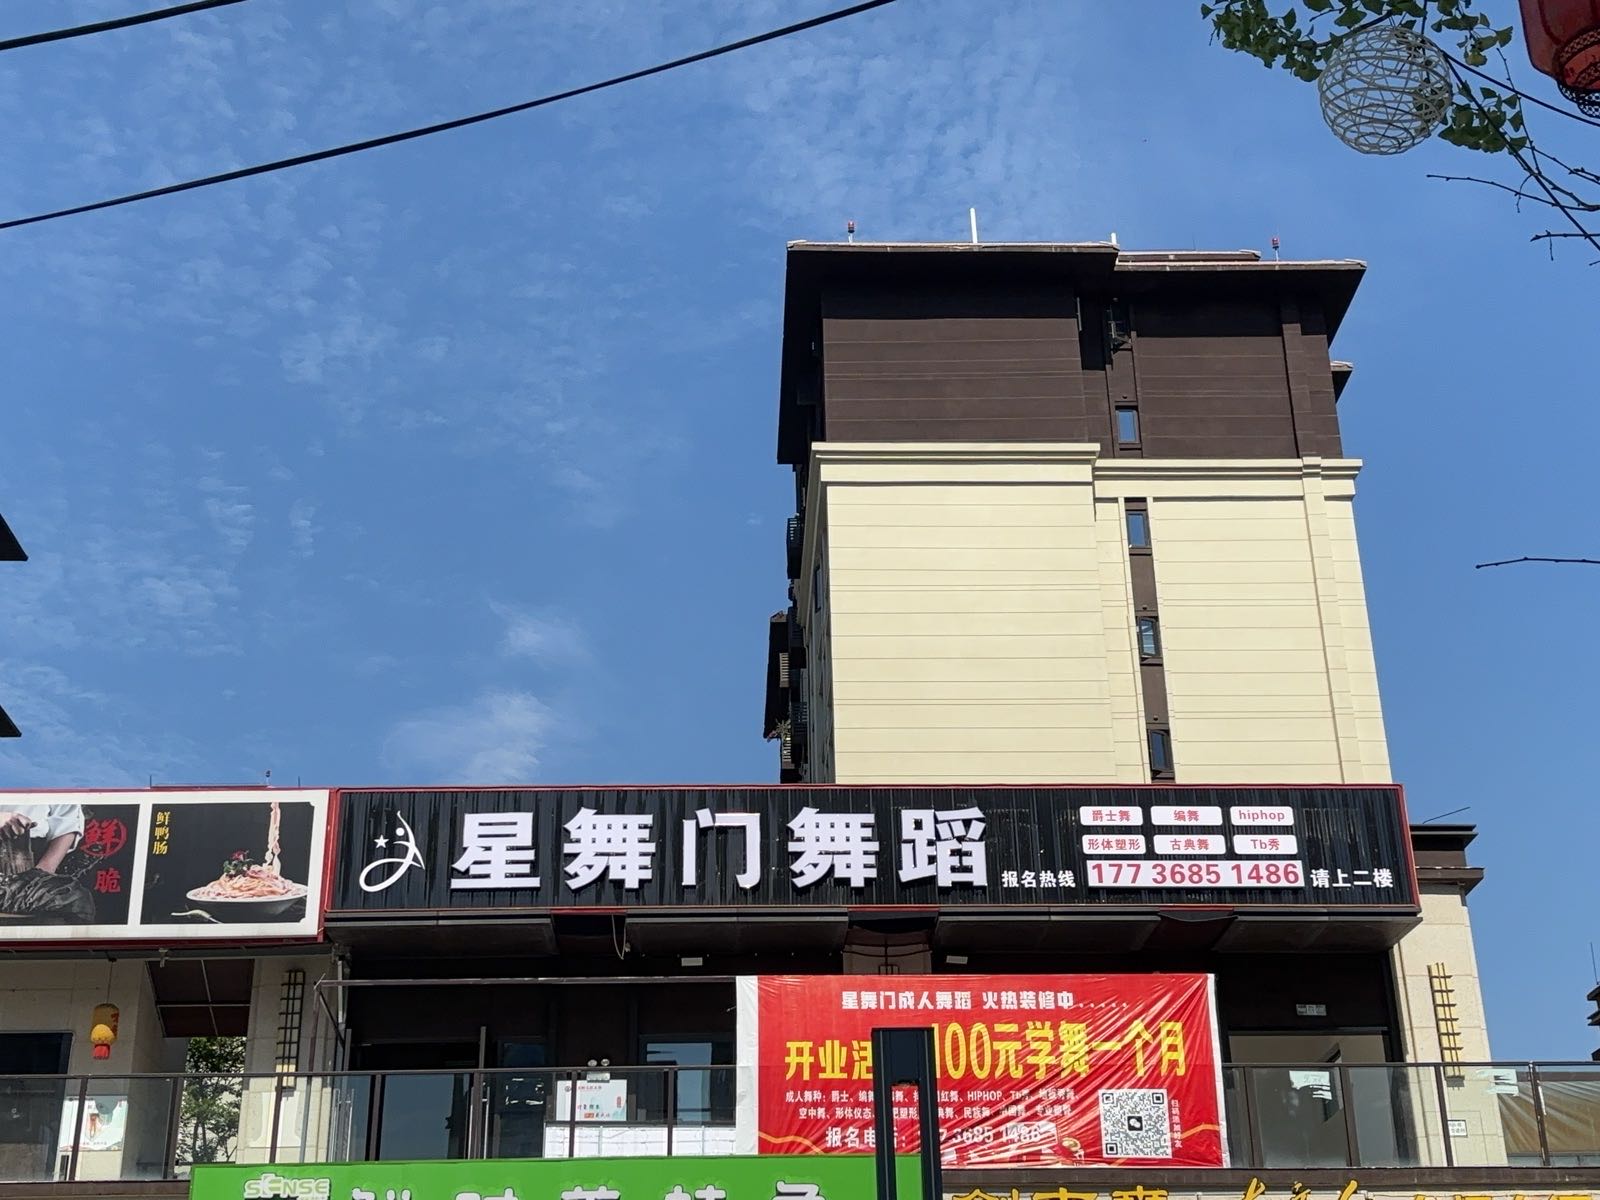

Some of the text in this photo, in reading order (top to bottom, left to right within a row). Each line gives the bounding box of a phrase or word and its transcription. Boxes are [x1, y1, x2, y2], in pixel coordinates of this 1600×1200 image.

[1092, 809, 1131, 823] 爵士舞
[1173, 809, 1200, 823] 编舞
[1239, 809, 1285, 823] hiphop
[450, 807, 988, 889] 星舞门舞蹈
[1087, 838, 1141, 852] 形体塑形
[1169, 838, 1210, 852] 古典舞
[1250, 838, 1280, 852] Tb秀
[1001, 869, 1077, 889] 报名热线
[1091, 862, 1301, 886] 177 3685 1486
[1309, 868, 1395, 890] 请上二楼
[841, 990, 972, 1011] 星舞门成人舞蹈
[784, 1039, 874, 1081] 开业活
